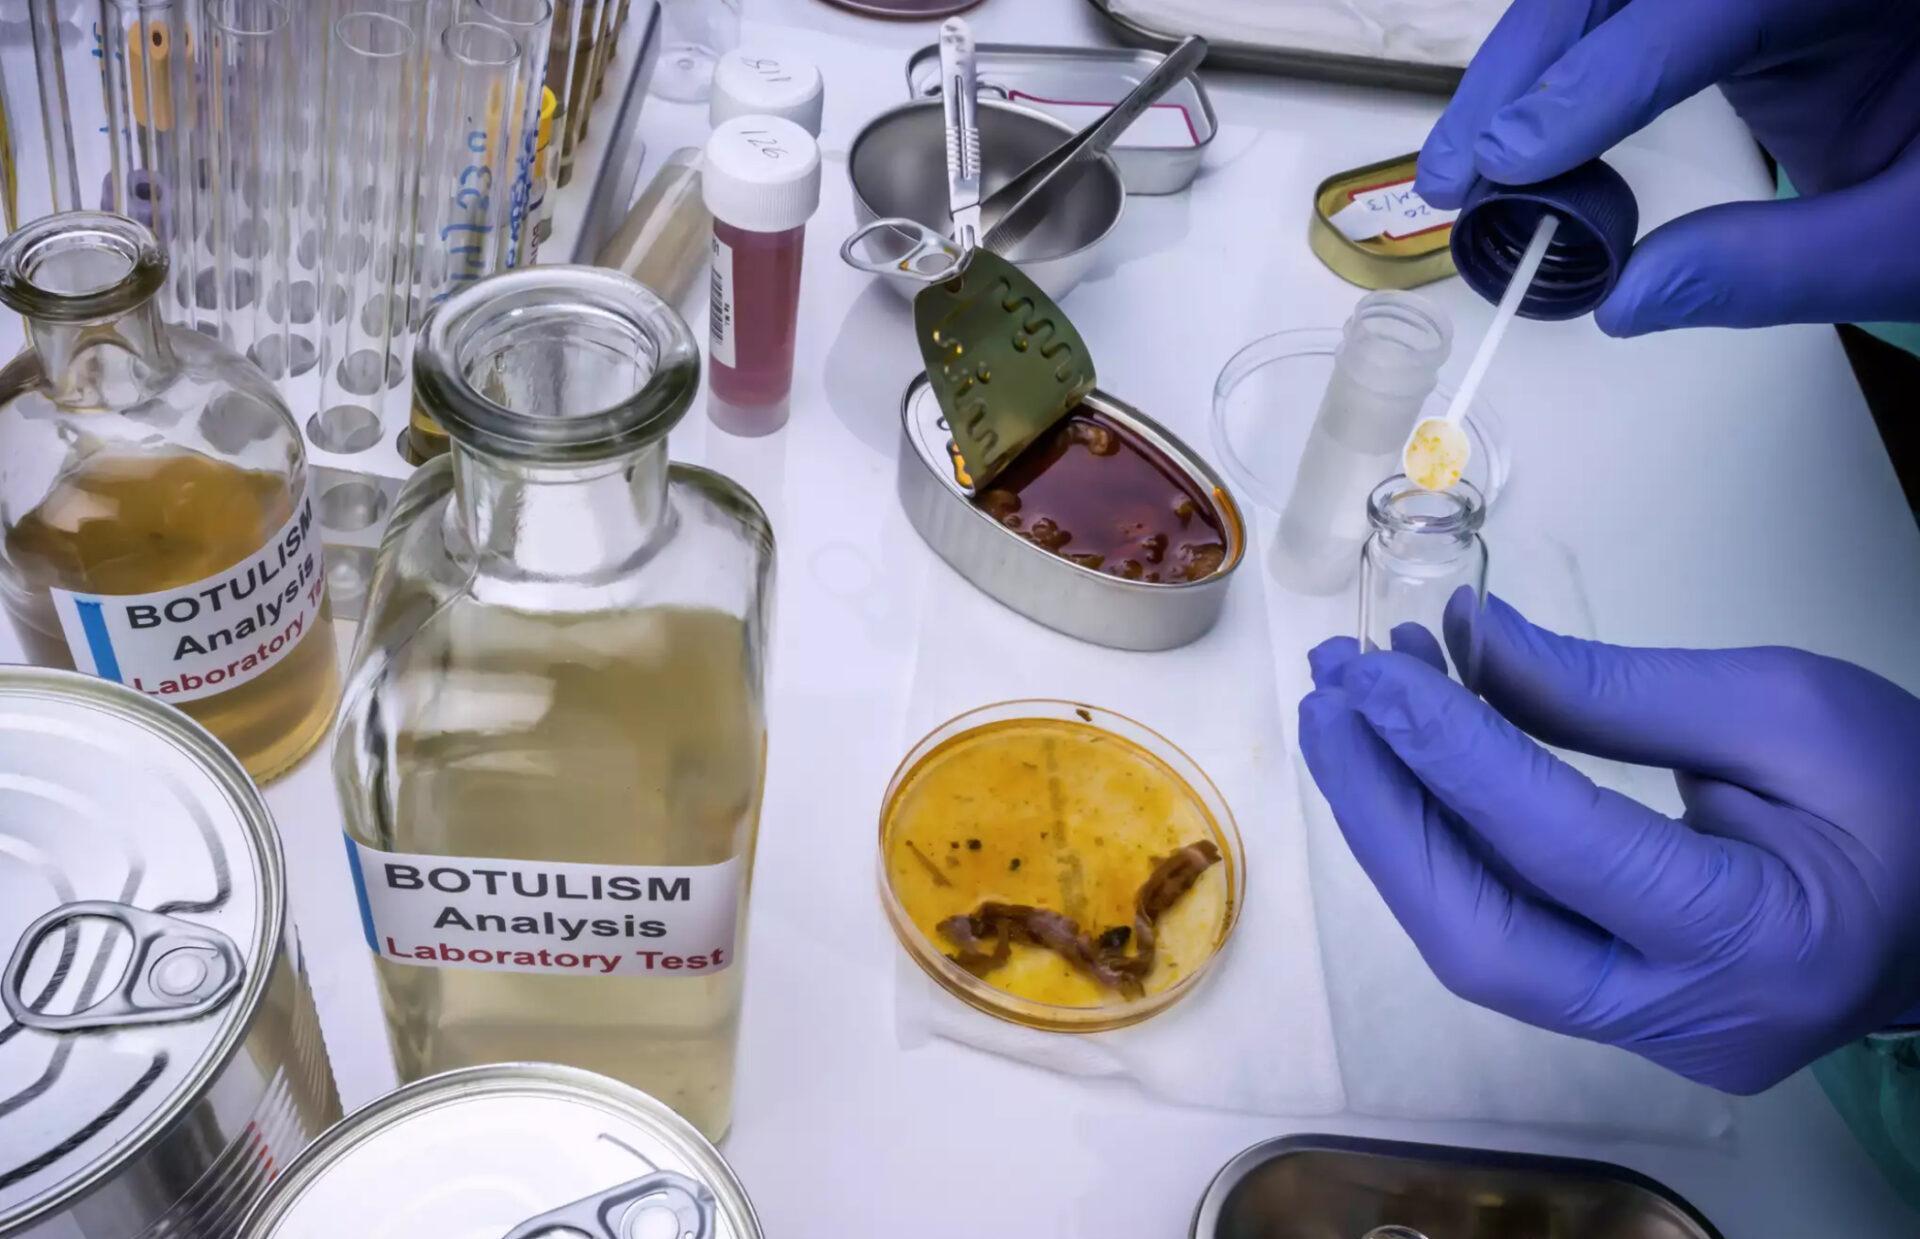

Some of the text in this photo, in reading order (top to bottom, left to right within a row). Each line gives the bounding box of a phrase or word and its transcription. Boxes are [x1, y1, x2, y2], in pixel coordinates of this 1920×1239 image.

[740, 130, 789, 159] 126
[125, 496, 313, 629] BOTULISM
[173, 552, 314, 661] Analysis
[133, 610, 304, 695] Laboratory
[384, 863, 692, 902] BOTULISM
[433, 906, 668, 942] Analysis
[386, 936, 725, 973] Laboratory Test
